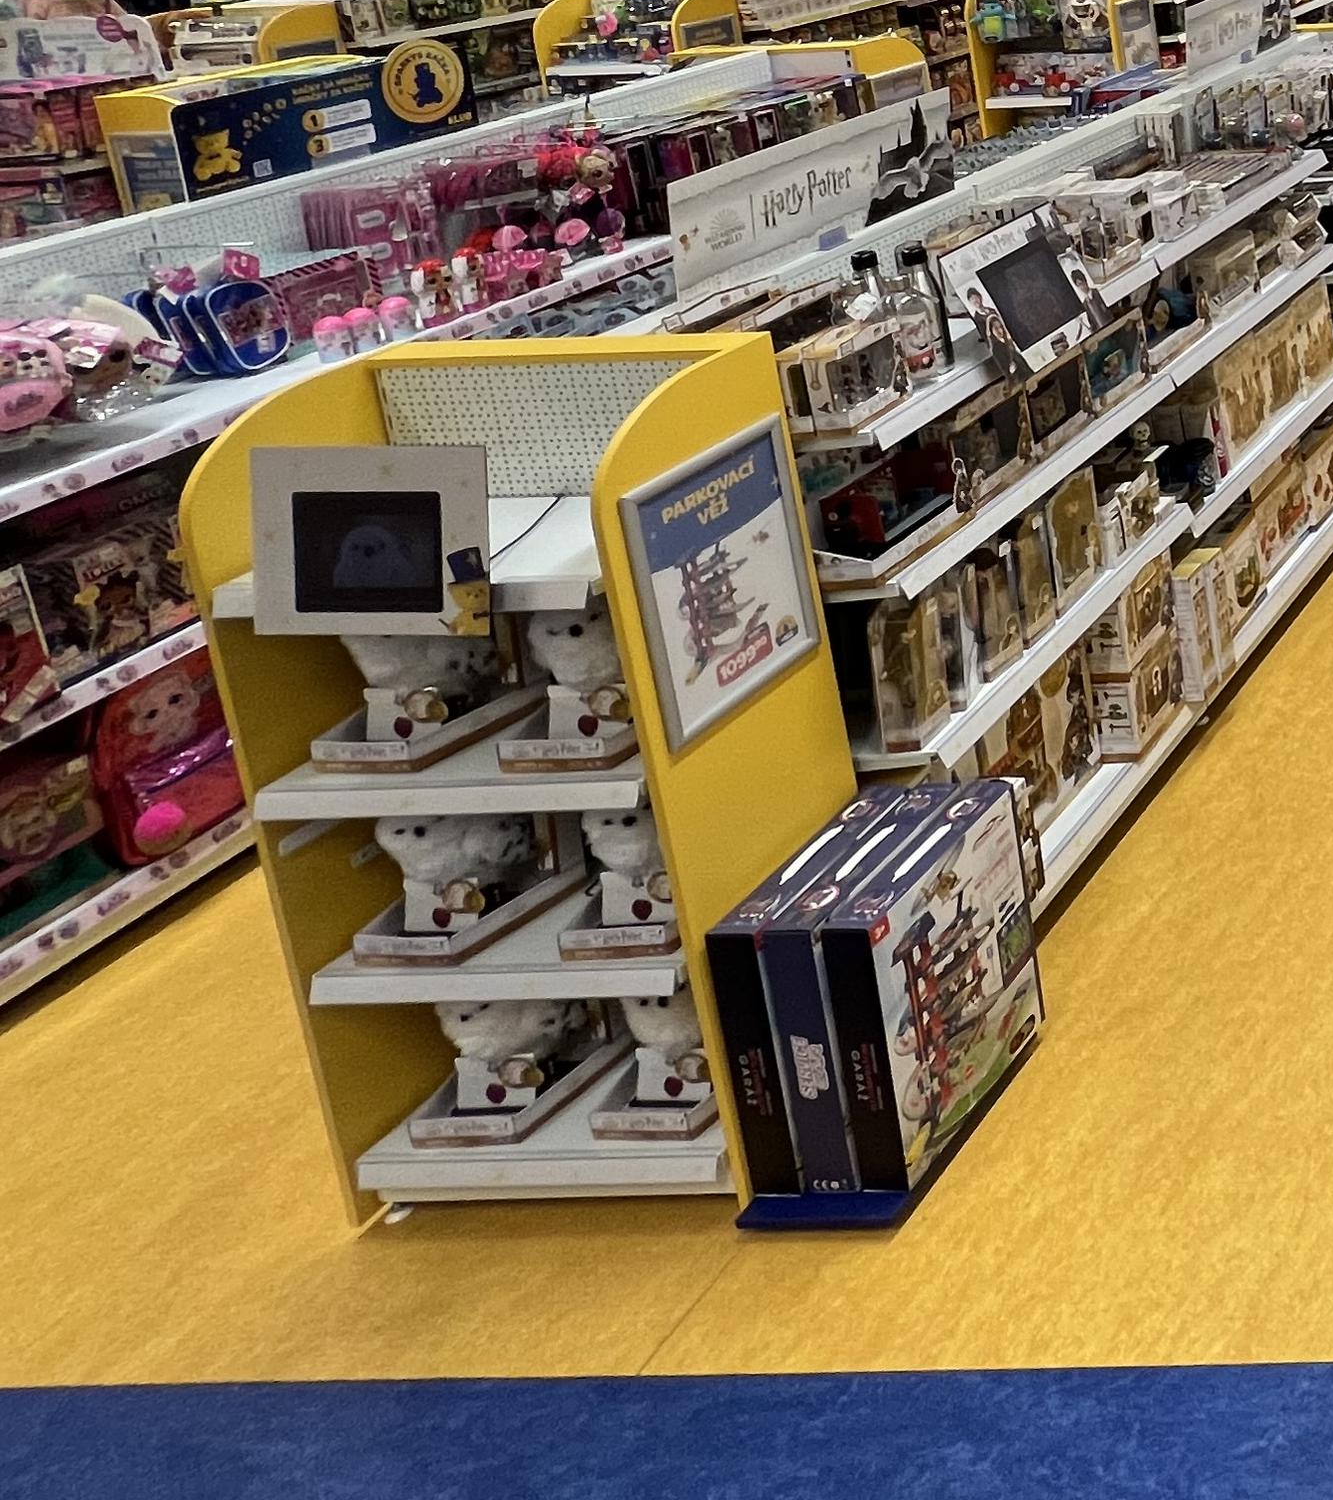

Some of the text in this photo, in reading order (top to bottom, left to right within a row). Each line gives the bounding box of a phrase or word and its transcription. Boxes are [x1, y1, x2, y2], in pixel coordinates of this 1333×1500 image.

[760, 166, 852, 228] Harry Potter
[660, 453, 755, 525] PARKOVACÍ
[696, 492, 730, 526] VĚŽ
